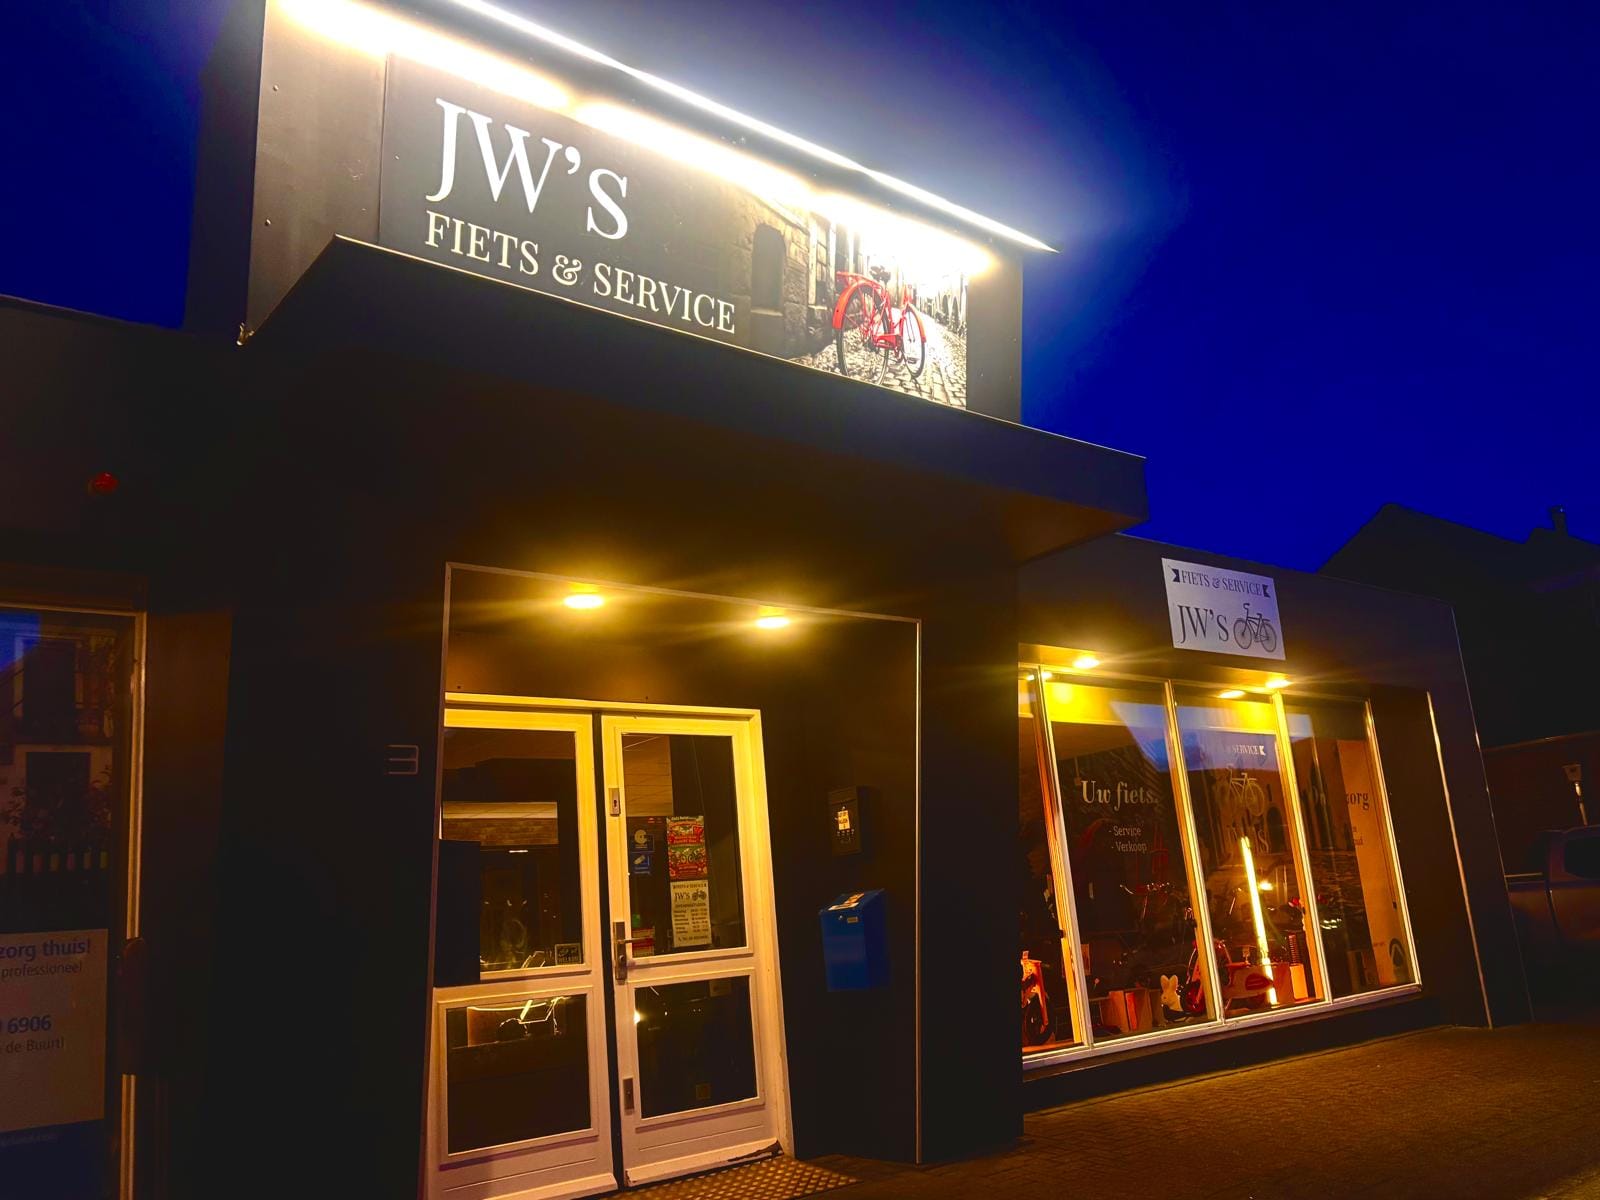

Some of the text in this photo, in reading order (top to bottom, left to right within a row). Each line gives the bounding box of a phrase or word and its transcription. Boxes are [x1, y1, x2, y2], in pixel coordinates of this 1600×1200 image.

[425, 210, 736, 334] FIETS & SERVICE
[1181, 570, 1263, 596] FIETS & SERVICE
[1081, 780, 1111, 804] Uw
[1113, 824, 1142, 836] Service
[1115, 841, 1148, 855] Verkoop
[1, 960, 82, 978] professioneel
[7, 1014, 52, 1034] 6906
[6, 1040, 22, 1054] de
